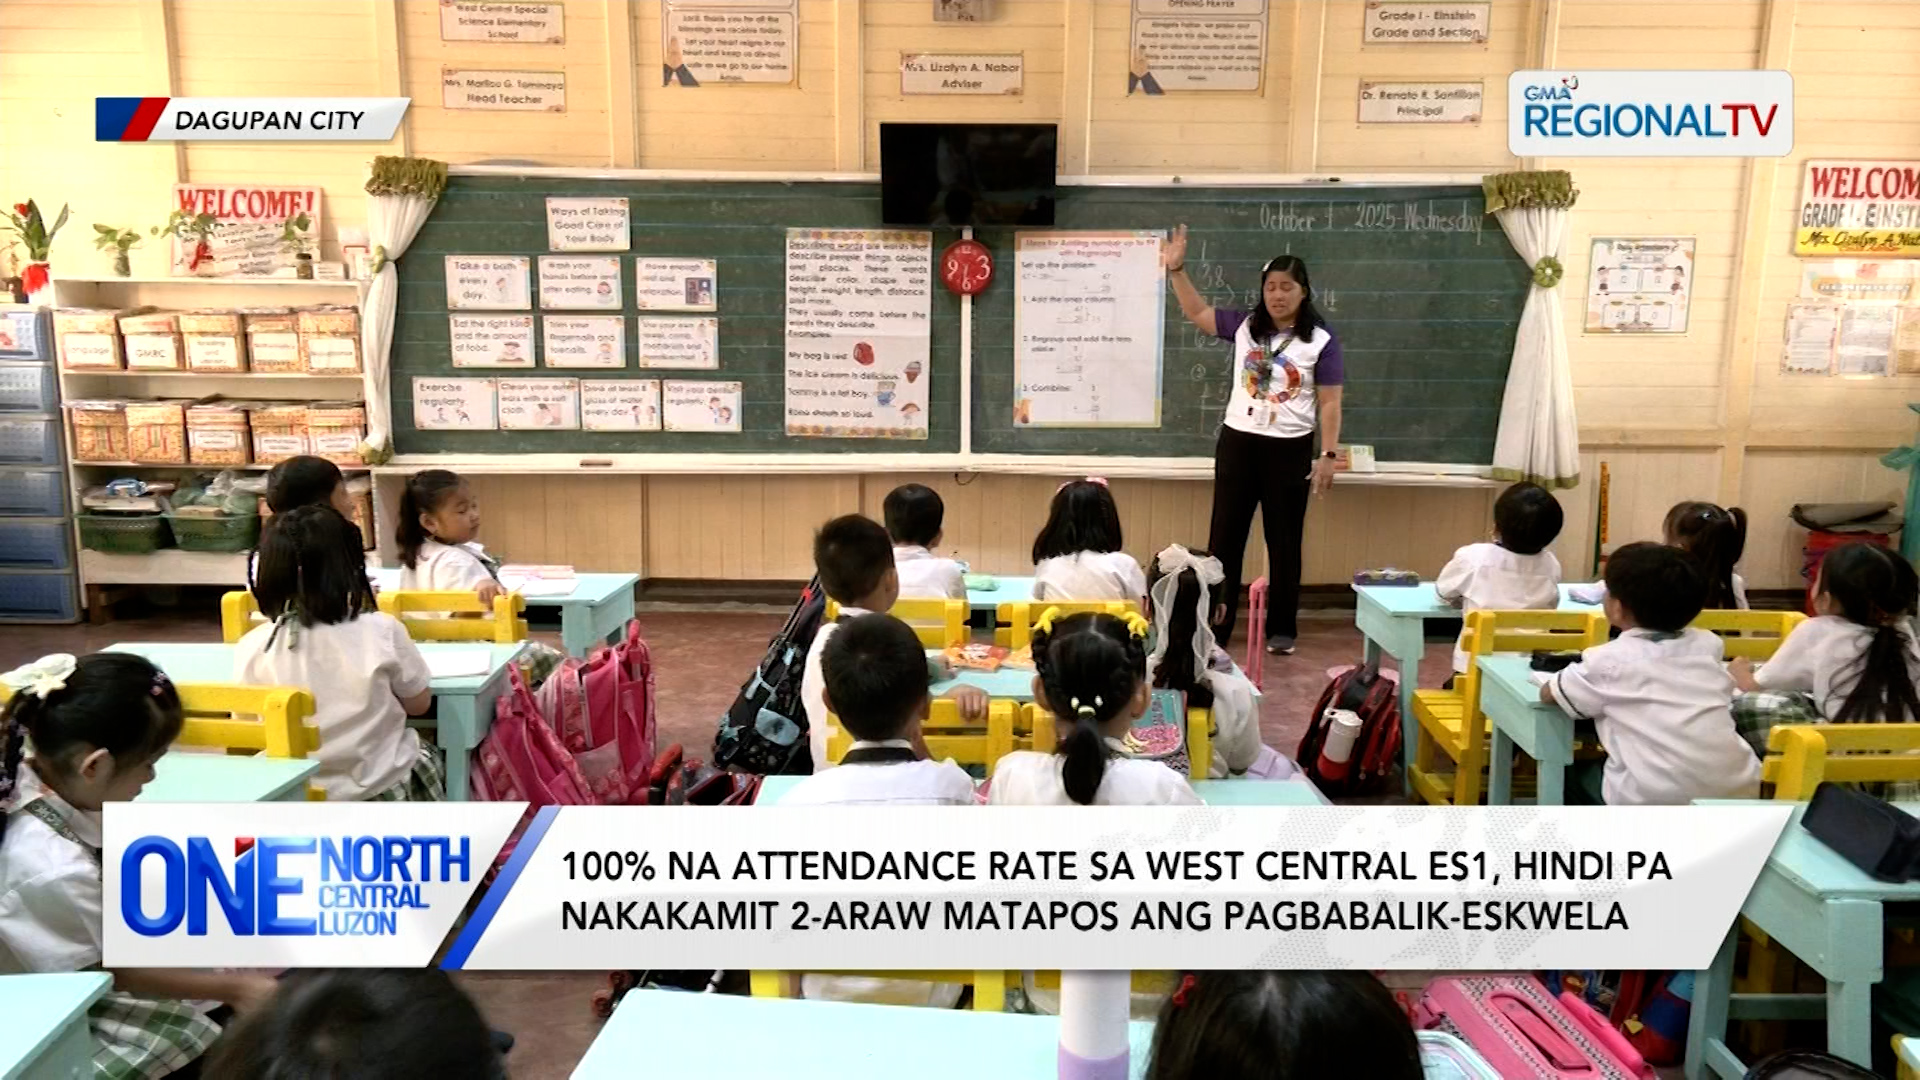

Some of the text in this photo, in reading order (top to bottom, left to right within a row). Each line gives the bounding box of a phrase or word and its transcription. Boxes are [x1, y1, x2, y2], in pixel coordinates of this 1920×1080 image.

[1379, 11, 1416, 21] Grade
[1372, 27, 1480, 38] Grade and Section
[941, 79, 983, 89] Adviser
[467, 93, 542, 104] Head Teacher
[177, 189, 314, 219] WELCOME!
[551, 207, 626, 218] Ways of Taking
[1260, 200, 1317, 232] October
[554, 221, 584, 230] Good
[586, 221, 611, 230] Care
[590, 234, 614, 243] Body
[455, 261, 479, 270] Take
[947, 258, 959, 281] 9
[976, 255, 990, 280] 3
[470, 319, 486, 328] the
[454, 332, 473, 340] and
[475, 332, 490, 340] the
[419, 382, 463, 392] Exercise
